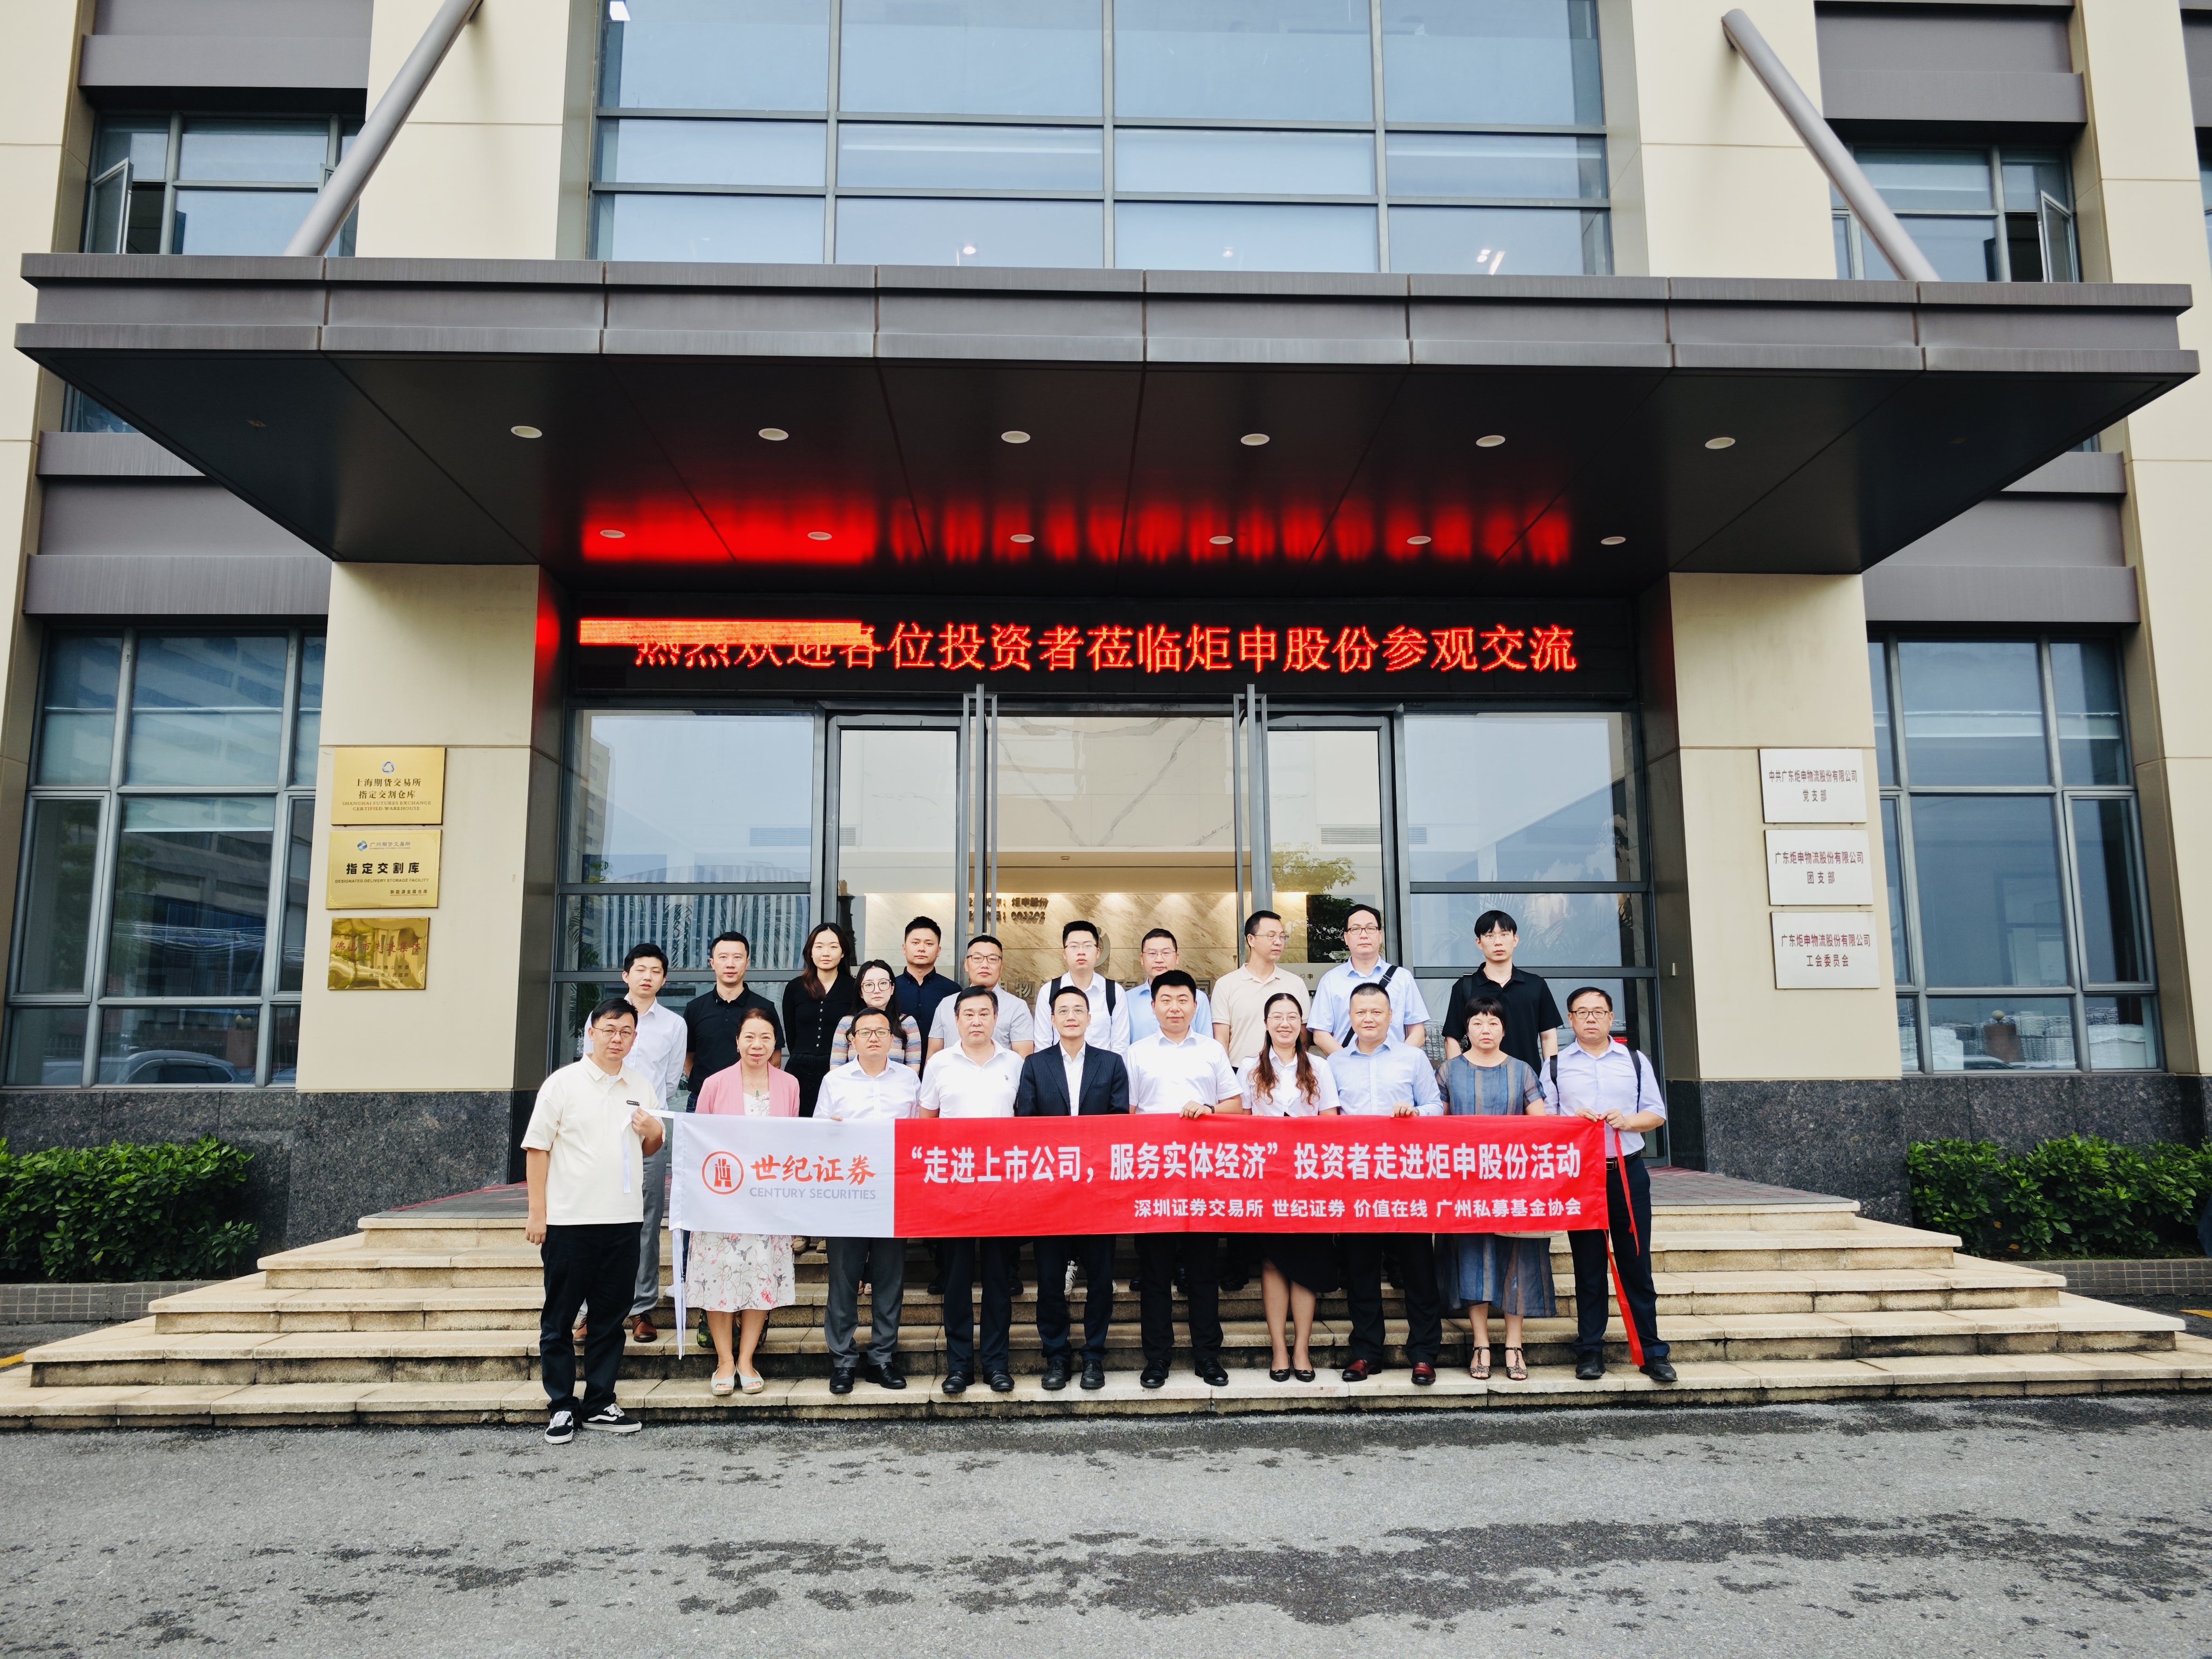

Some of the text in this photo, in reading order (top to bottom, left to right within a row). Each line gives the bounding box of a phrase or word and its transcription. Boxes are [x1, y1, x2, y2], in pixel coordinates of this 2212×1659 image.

[355, 778, 421, 787] 上海期货交易所
[1769, 770, 1858, 783] 中共广东炬申物流股份有限公司
[359, 790, 416, 799] 指定交割仓库
[1802, 789, 1827, 802] 党支部
[1775, 851, 1864, 865] 广东炬申物流股份有限公司
[346, 862, 420, 875] 指定交割库
[1806, 871, 1835, 885] 团支部
[335, 941, 422, 954] 佛山市先进集体
[1781, 934, 1871, 948] 广东炬申物流股份有限公司
[1806, 954, 1849, 968] 工会委员会
[750, 1154, 876, 1185] 世纪证券
[750, 1187, 876, 1200] CENTURY SECURITIES
[1134, 1197, 1581, 1218] 深圳证券交易所 世纪证券 价值在线 广州私募基金协会
